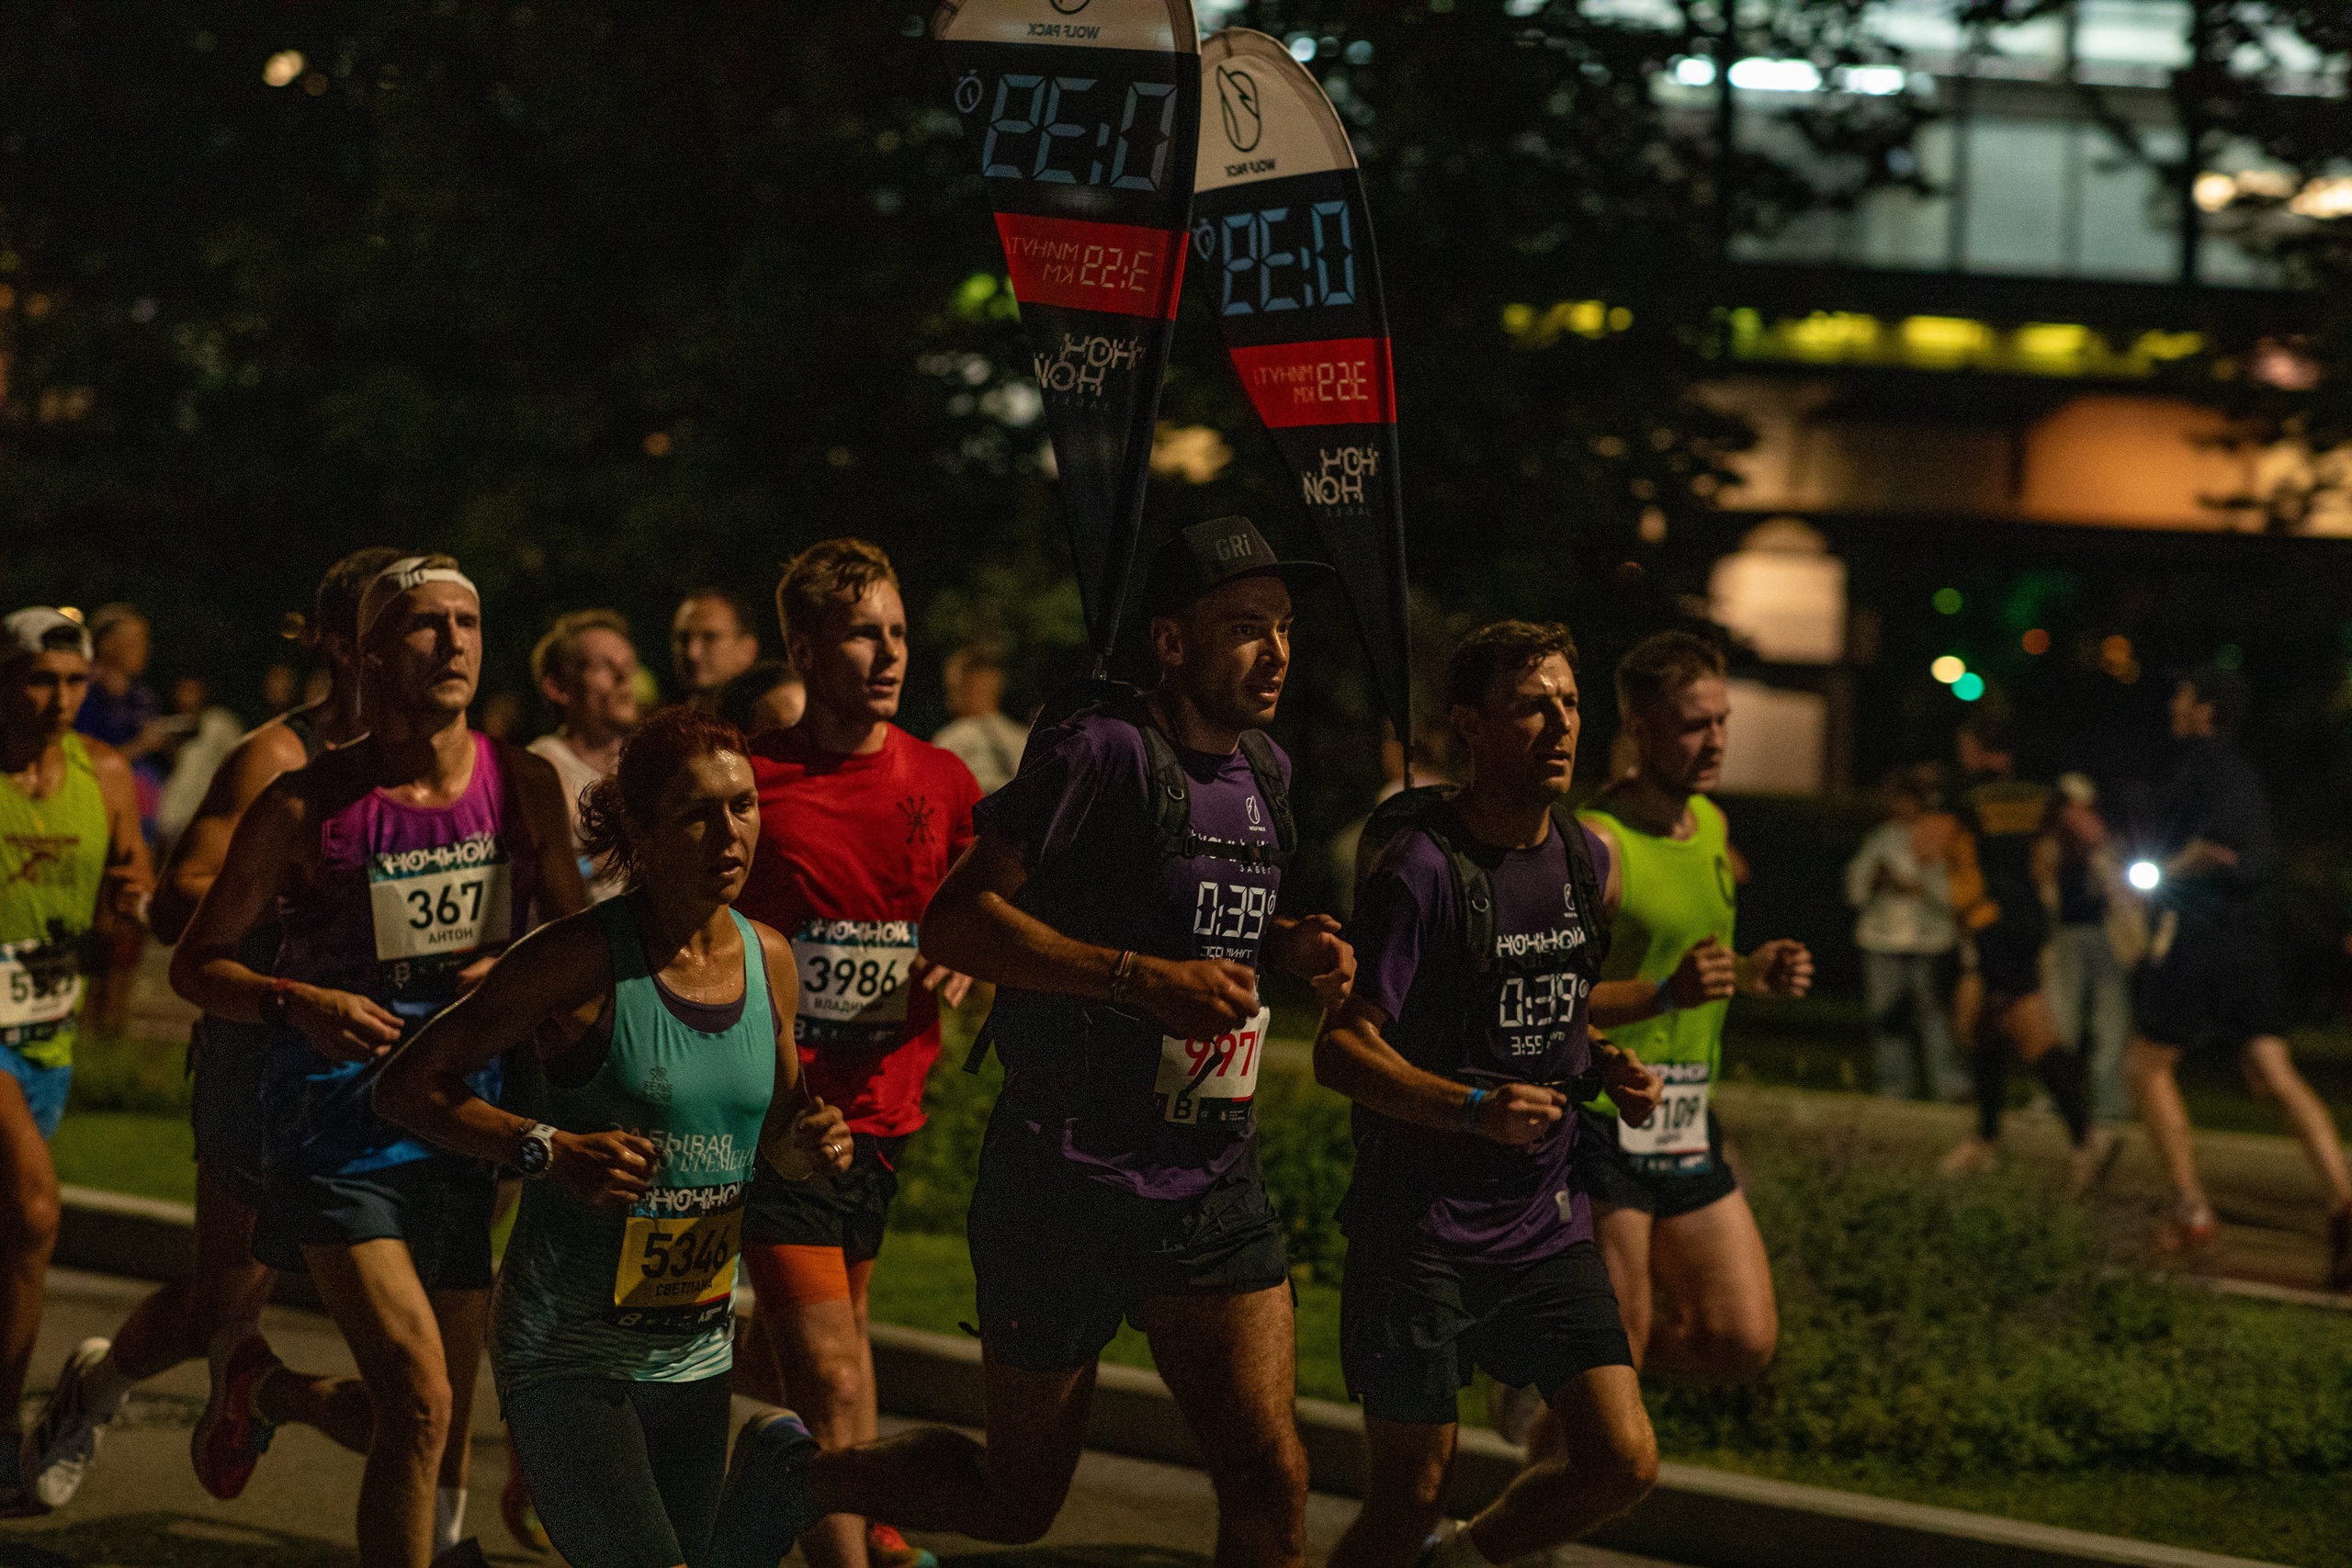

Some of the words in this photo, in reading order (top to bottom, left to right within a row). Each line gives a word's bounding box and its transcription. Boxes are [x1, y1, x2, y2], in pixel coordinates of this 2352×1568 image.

[406, 880, 484, 930] 367
[1193, 880, 1267, 940] 0:39
[428, 928, 473, 945] АНТОН
[804, 956, 897, 997] 3986
[1498, 972, 1578, 1029] 0:39
[1641, 1096, 1700, 1131] 109
[641, 1224, 729, 1278] 5346
